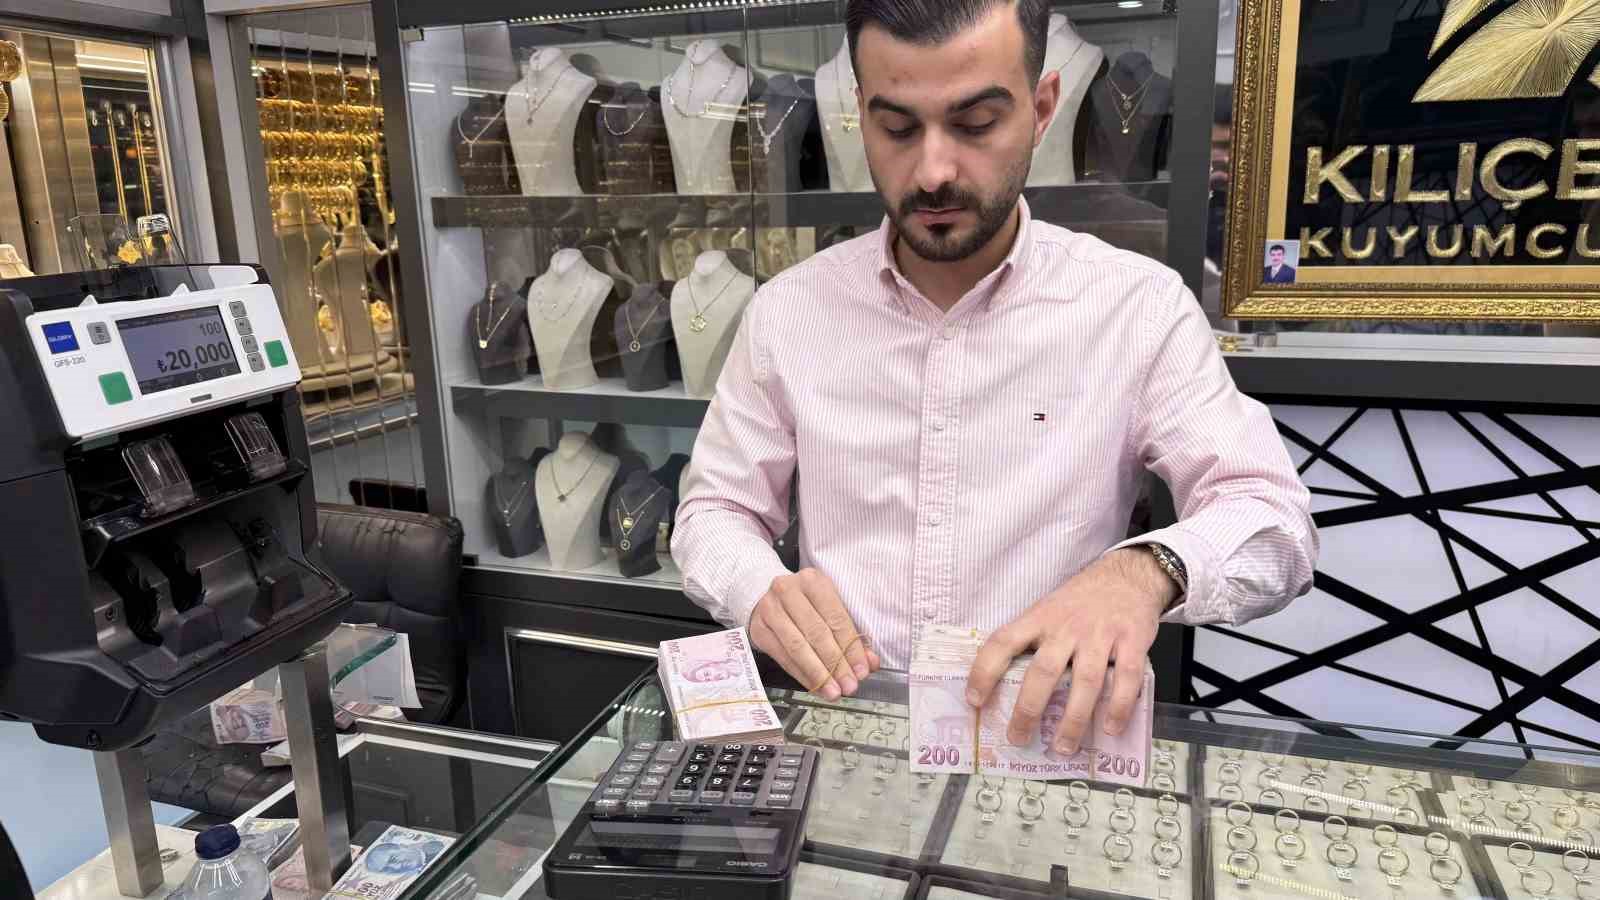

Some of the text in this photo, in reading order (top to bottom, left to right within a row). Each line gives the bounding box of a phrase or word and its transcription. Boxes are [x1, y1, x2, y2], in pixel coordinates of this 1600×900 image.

[1303, 137, 1600, 209] KILIÇE
[1301, 222, 1600, 259] KUYUMCU
[200, 321, 222, 336] 100
[918, 745, 960, 766] 200
[1097, 752, 1141, 778] 200
[726, 860, 769, 868] CASIO
